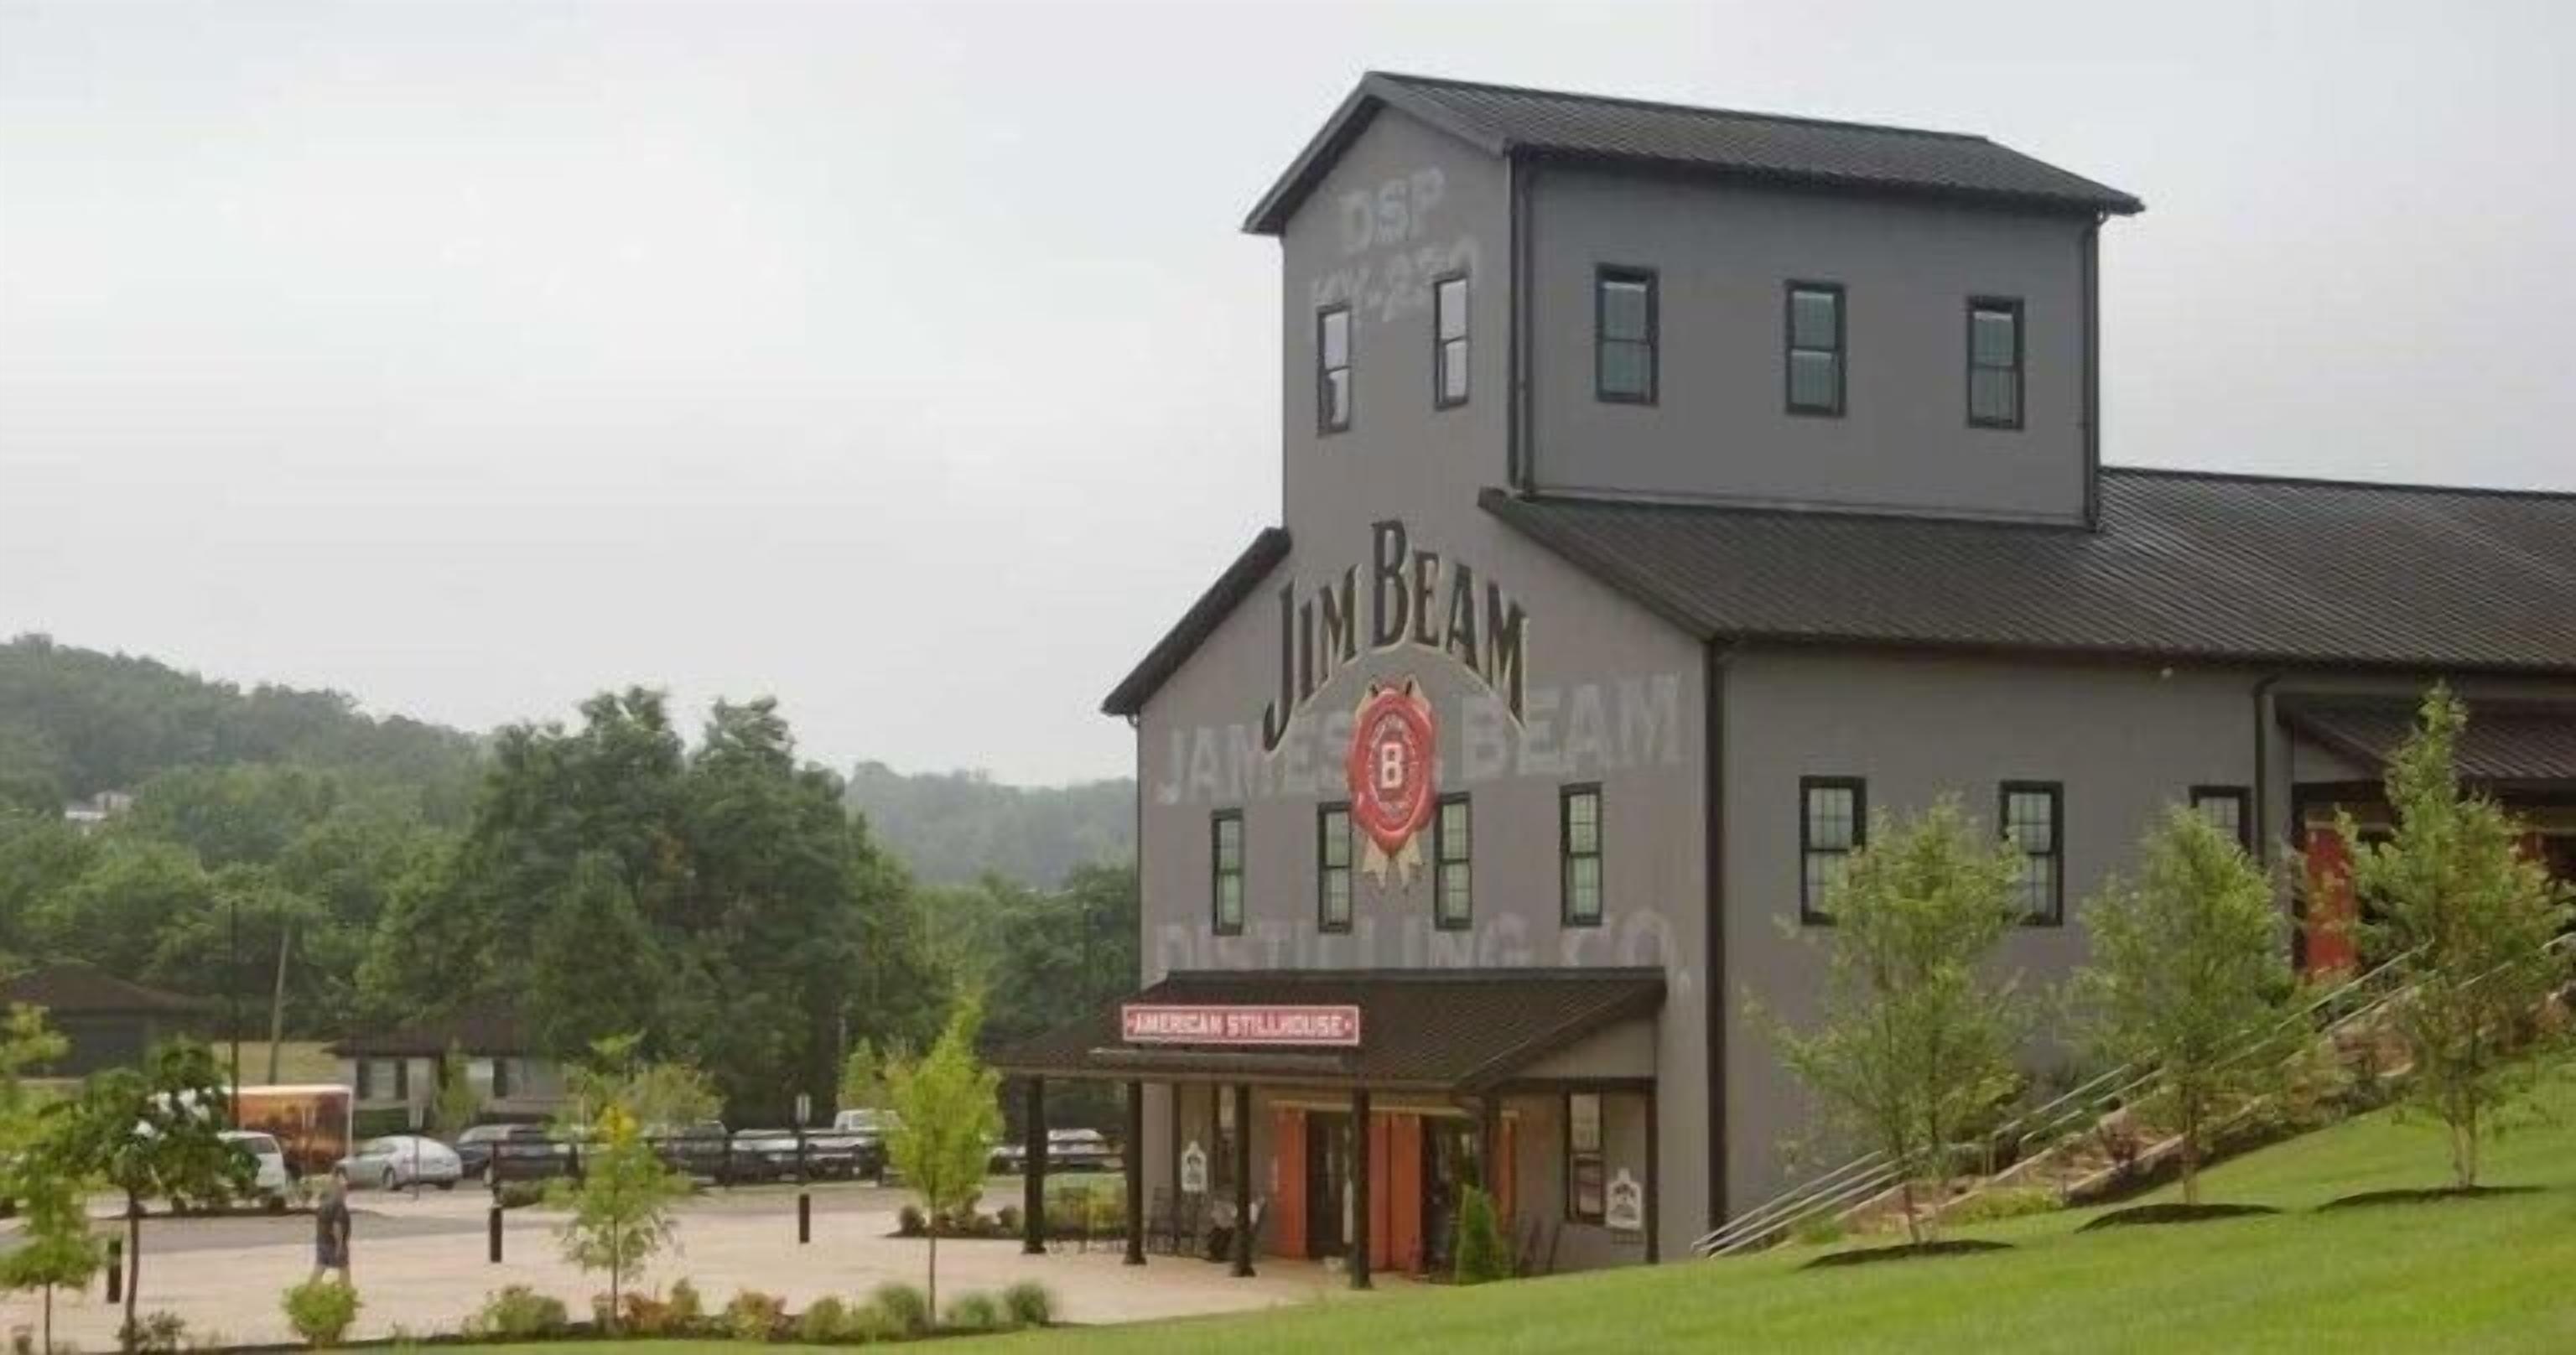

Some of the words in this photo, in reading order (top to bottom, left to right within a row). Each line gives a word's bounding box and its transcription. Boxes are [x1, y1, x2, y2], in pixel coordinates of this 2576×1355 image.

[1339, 166, 1446, 253] DSP
[1263, 562, 1362, 760] JIM
[1370, 518, 1529, 735] BEAM
[1156, 709, 1353, 807] JAMES
[1461, 672, 1682, 780] BEAM
[1379, 740, 1405, 790] B
[1135, 1011, 1223, 1036] AMERICAN
[1225, 1011, 1344, 1037] STILLHOUSE
